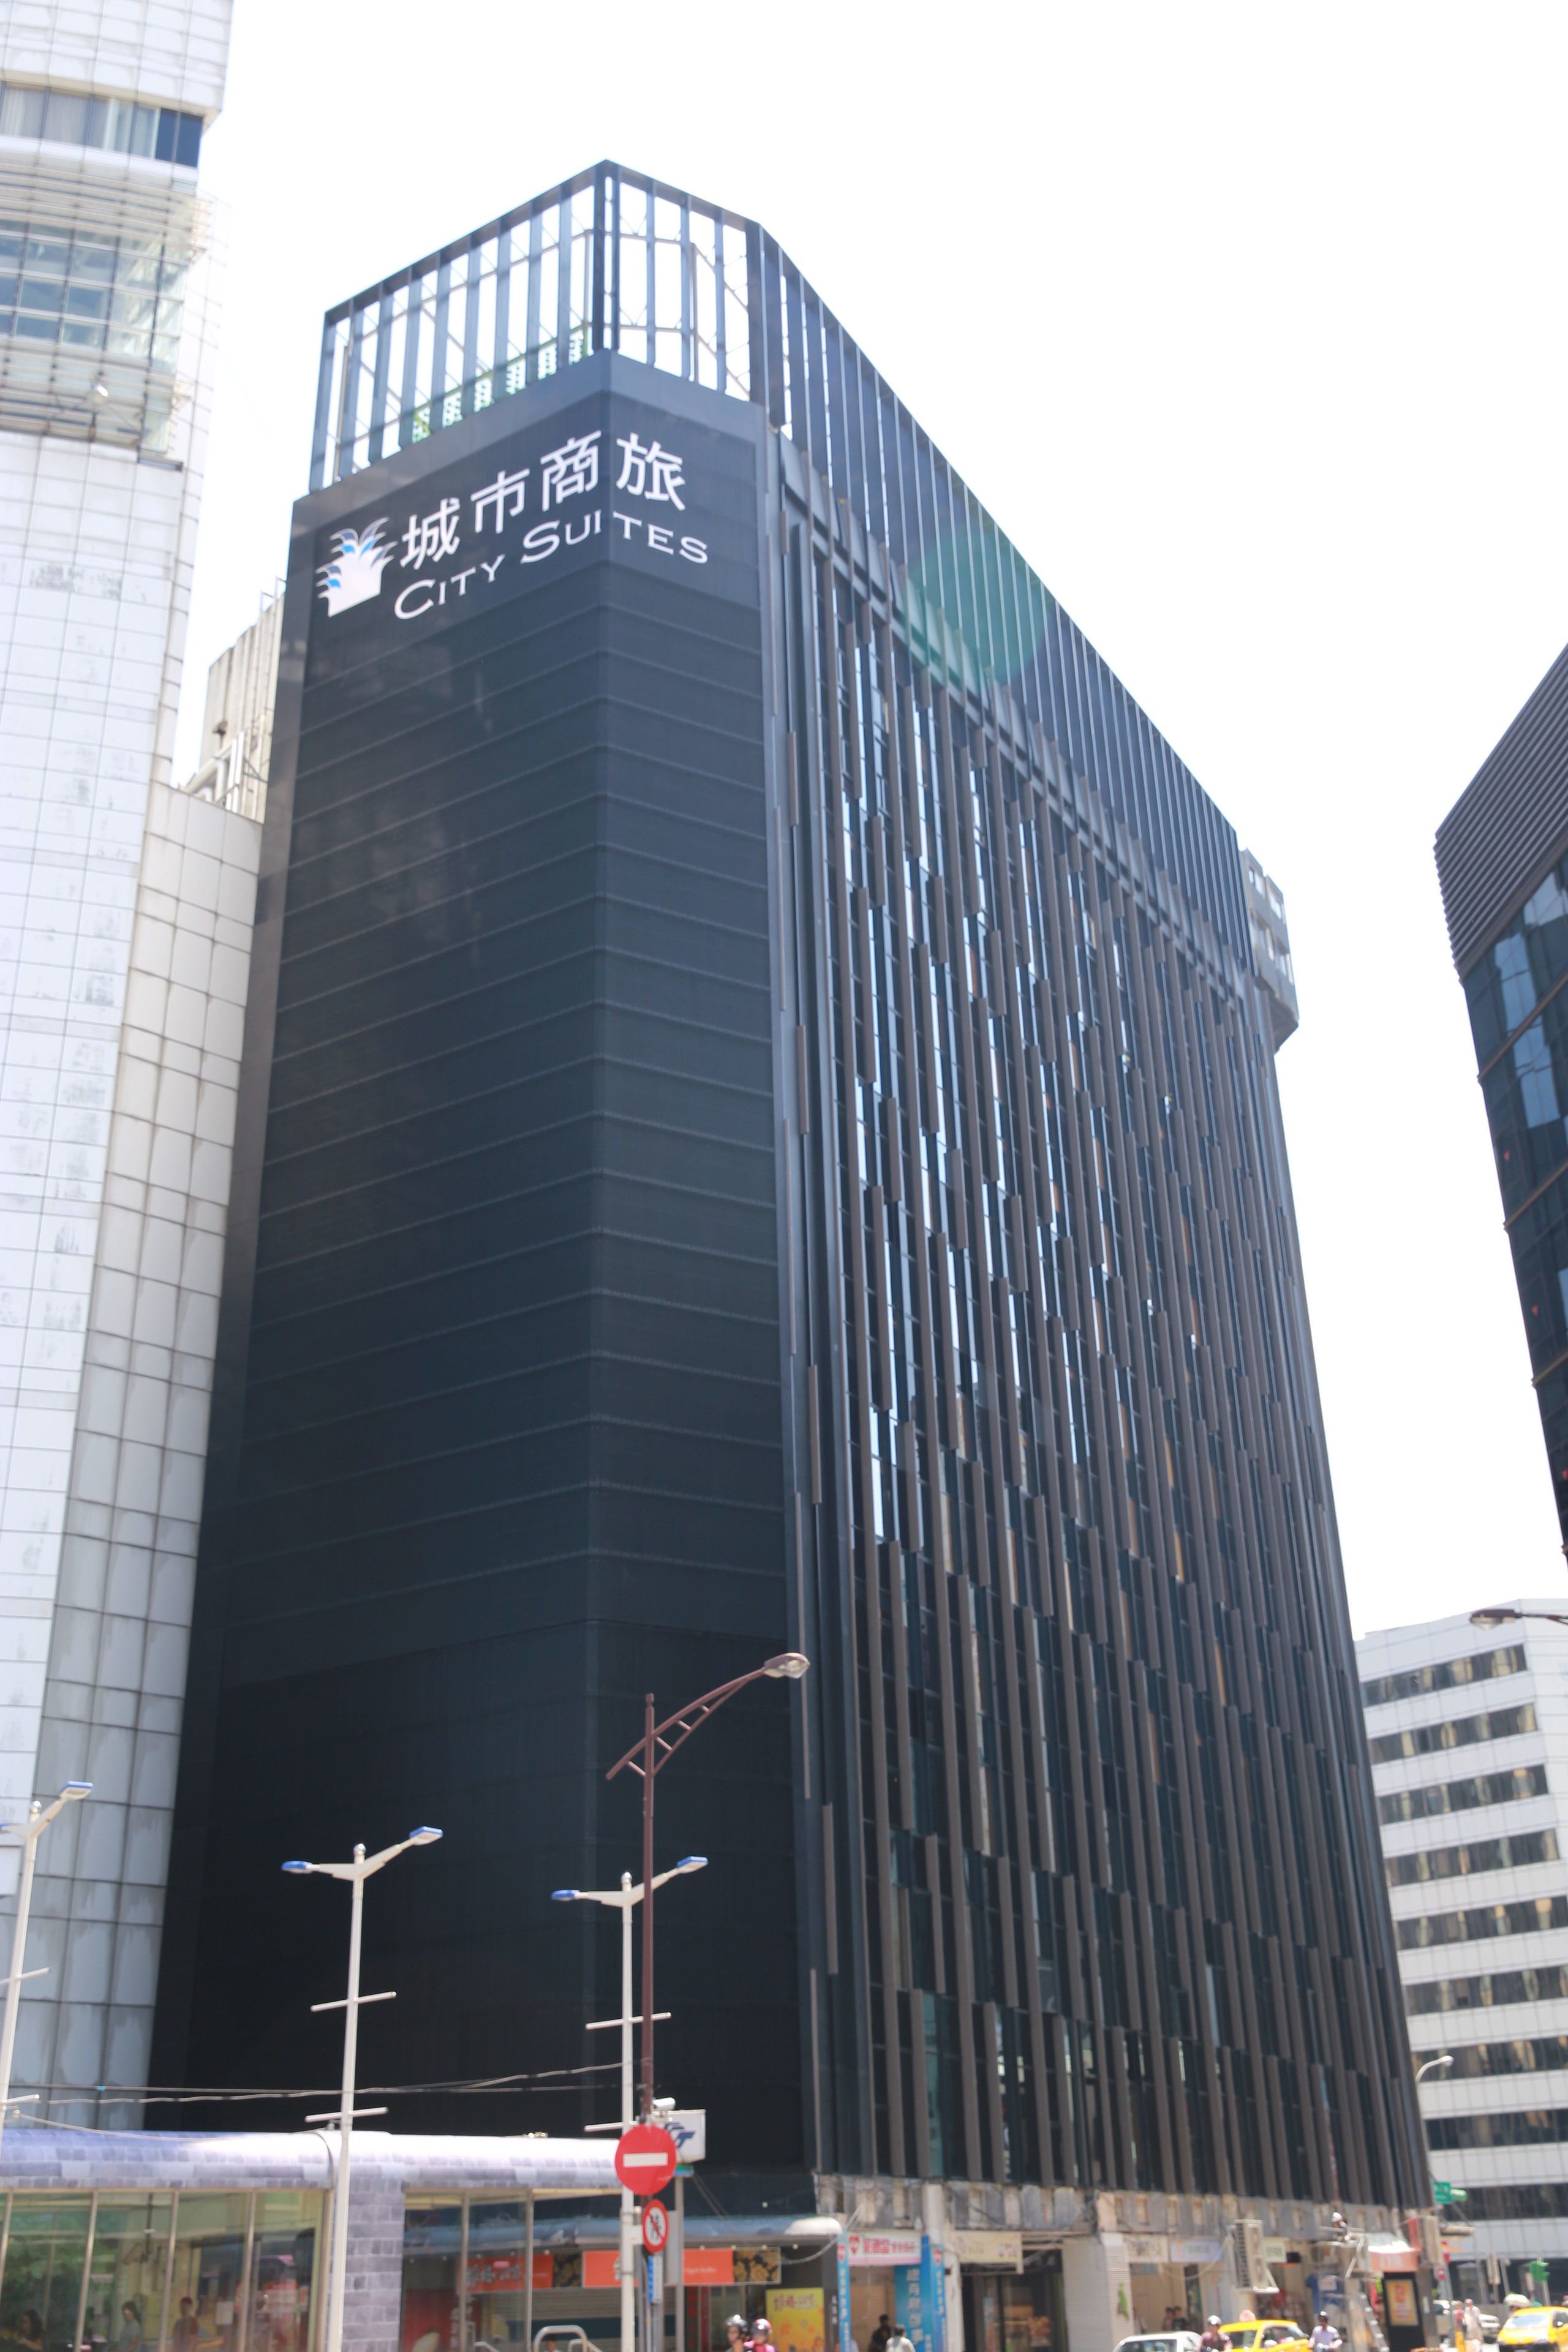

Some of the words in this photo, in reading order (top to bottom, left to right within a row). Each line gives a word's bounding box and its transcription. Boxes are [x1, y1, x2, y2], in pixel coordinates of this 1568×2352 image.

[400, 431, 687, 570] 城市商旅
[394, 555, 506, 620] CITY
